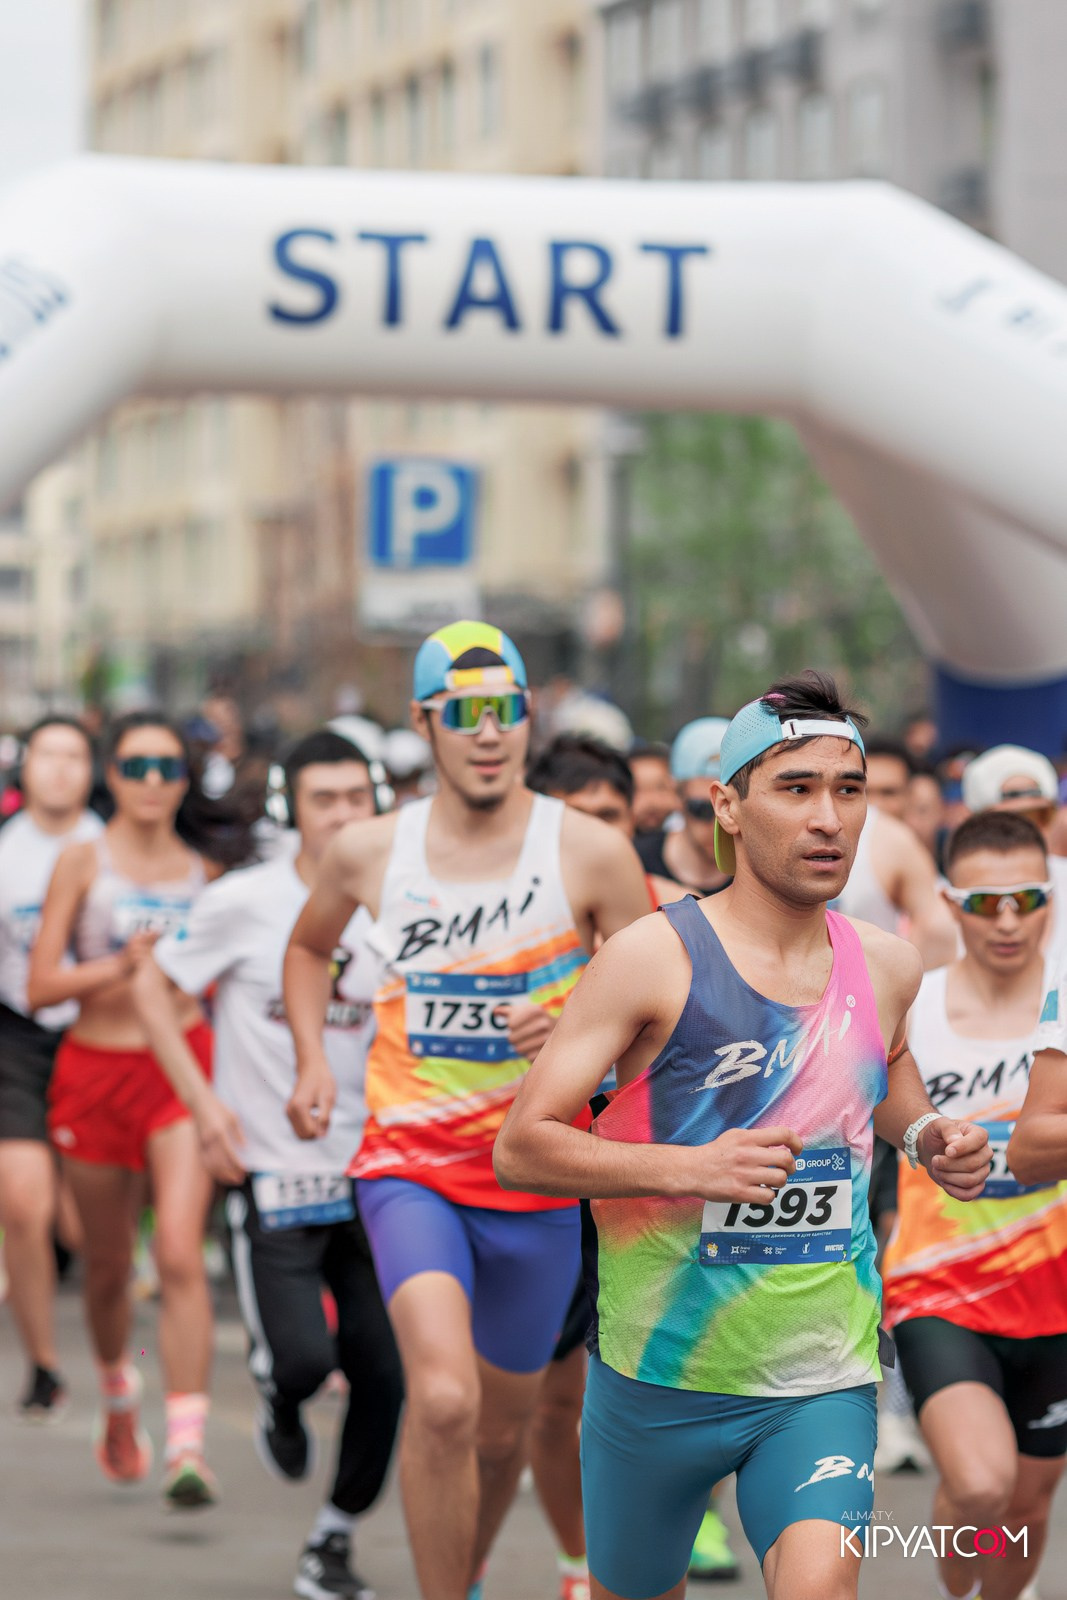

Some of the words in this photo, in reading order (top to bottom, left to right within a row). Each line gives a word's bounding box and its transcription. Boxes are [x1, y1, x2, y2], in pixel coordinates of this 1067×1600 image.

[267, 227, 709, 339] START
[393, 460, 460, 567] P
[806, 1158, 831, 1168] GROUP
[724, 1185, 838, 1229] 1593
